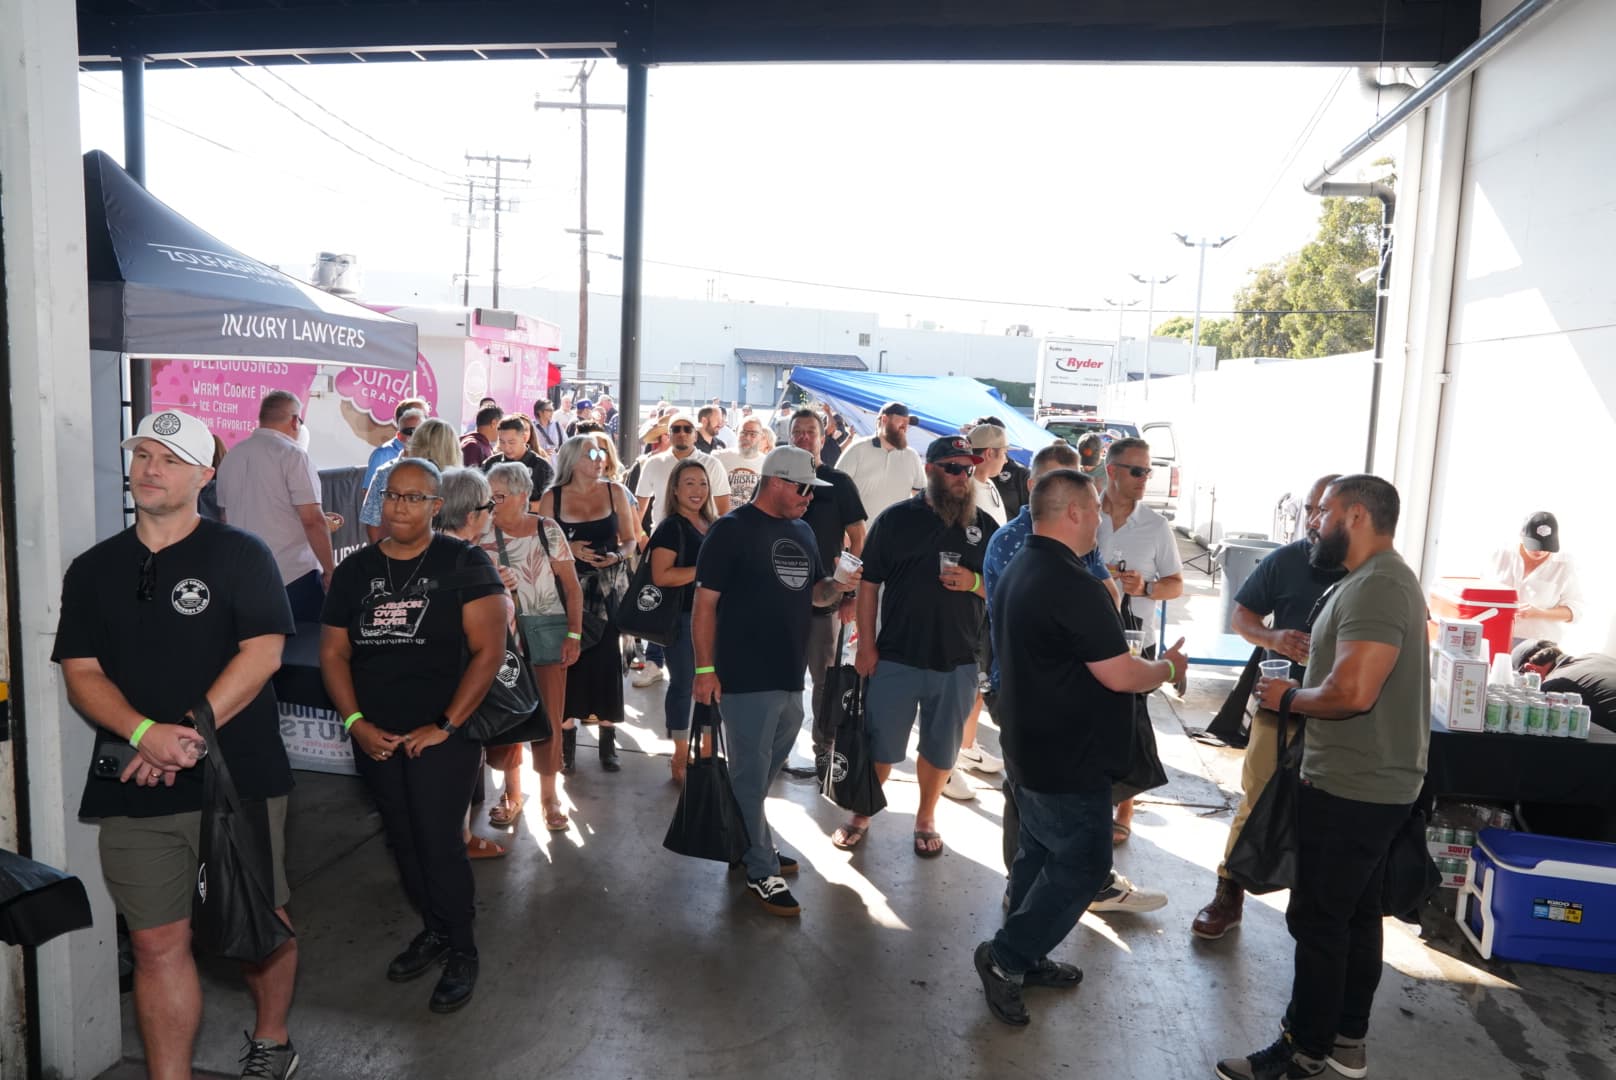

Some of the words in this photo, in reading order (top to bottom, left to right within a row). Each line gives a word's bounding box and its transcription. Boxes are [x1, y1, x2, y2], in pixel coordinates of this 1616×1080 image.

[221, 313, 288, 339] INJURY
[292, 319, 366, 348] LAWYERS
[1067, 357, 1104, 369] Ryder
[192, 380, 220, 398] WARM
[223, 381, 257, 399] COOKIE
[213, 400, 239, 414] CREAM
